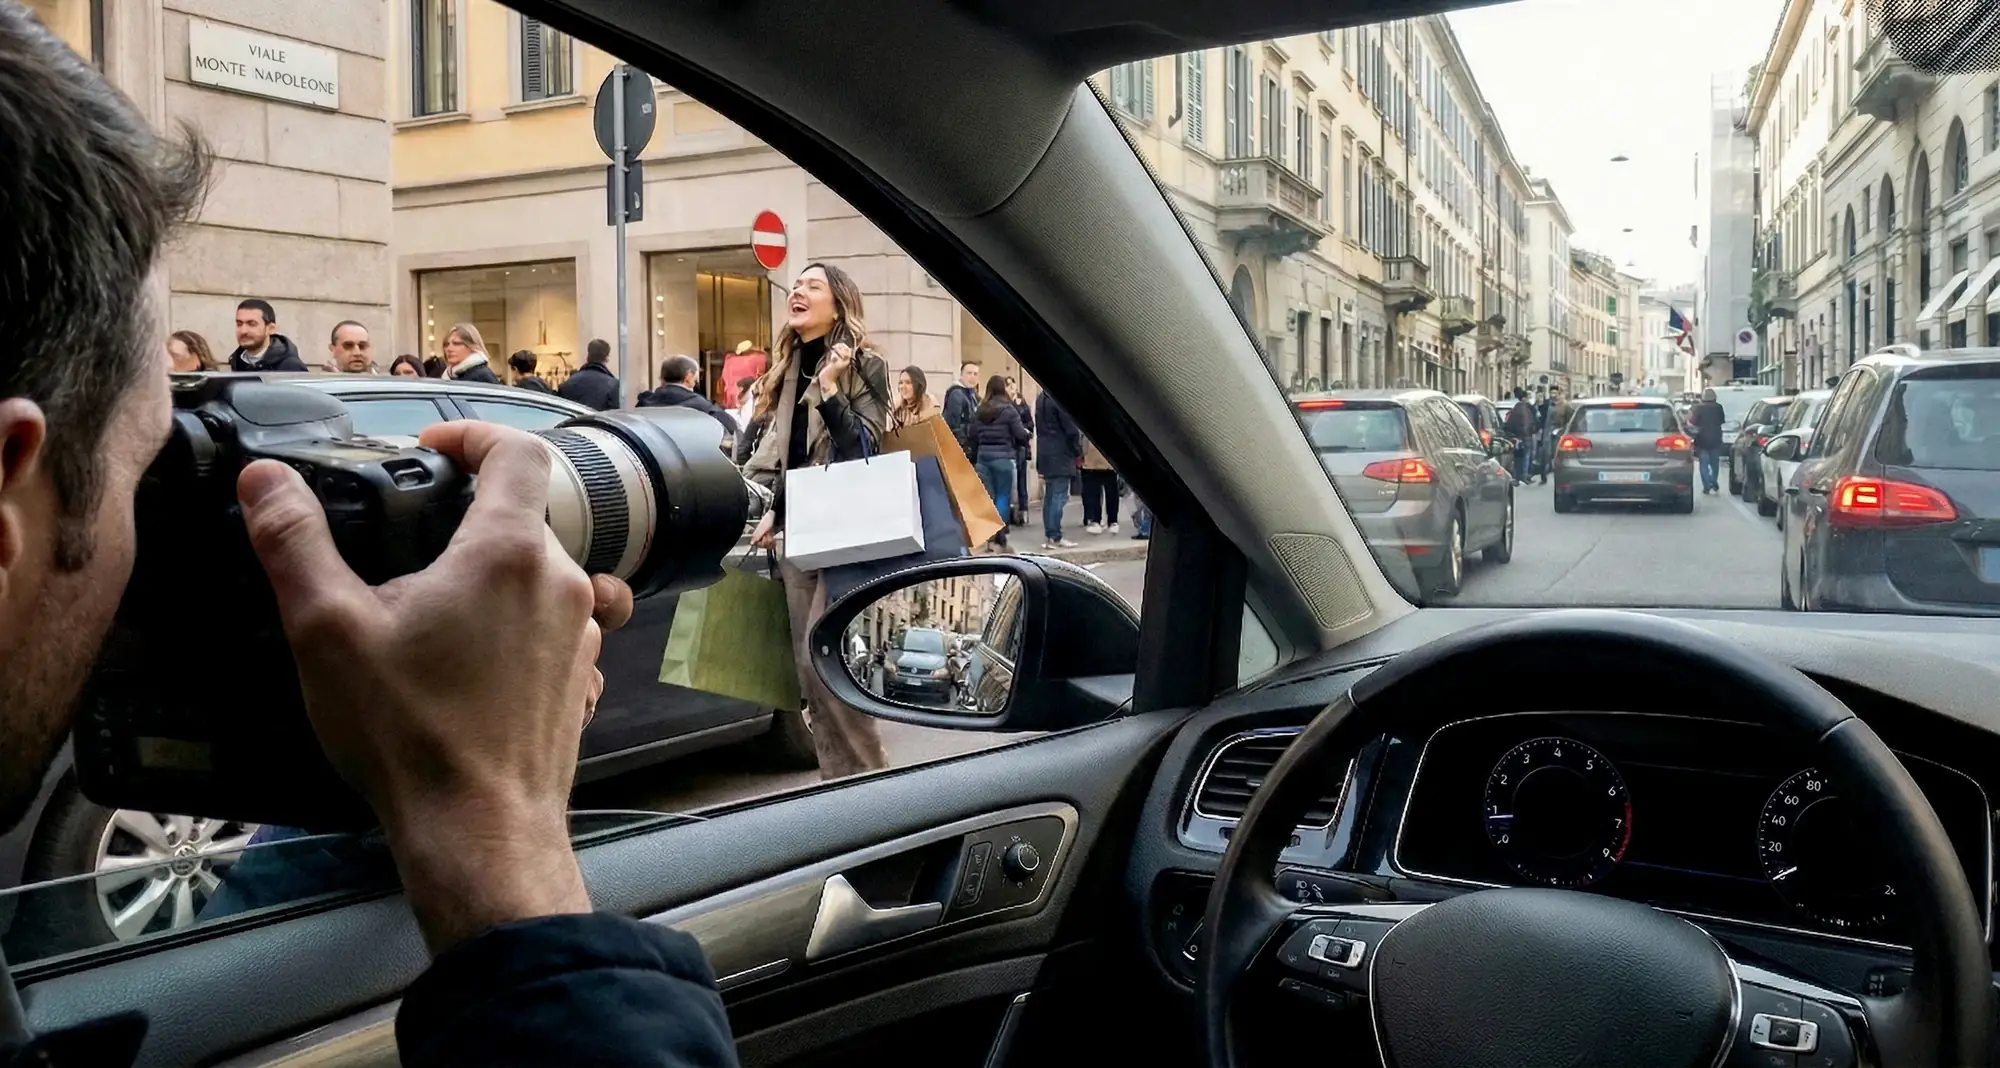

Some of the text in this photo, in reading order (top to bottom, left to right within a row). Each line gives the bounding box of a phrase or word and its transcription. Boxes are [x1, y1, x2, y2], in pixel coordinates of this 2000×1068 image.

[248, 43, 287, 63] VIALE
[195, 55, 335, 95] MONTE NAPOLEONE
[1553, 747, 1562, 758] 4
[1523, 753, 1530, 764] 3
[1586, 760, 1594, 771] 5
[1500, 773, 1508, 785] 2
[1608, 786, 1616, 797] 6
[1806, 780, 1822, 792] 80
[1784, 795, 1800, 806] 60
[1614, 818, 1623, 829] 7
[1771, 814, 1786, 826] 40
[1501, 834, 1509, 844] 0
[1602, 847, 1610, 858] 9
[1768, 841, 1782, 853] 20
